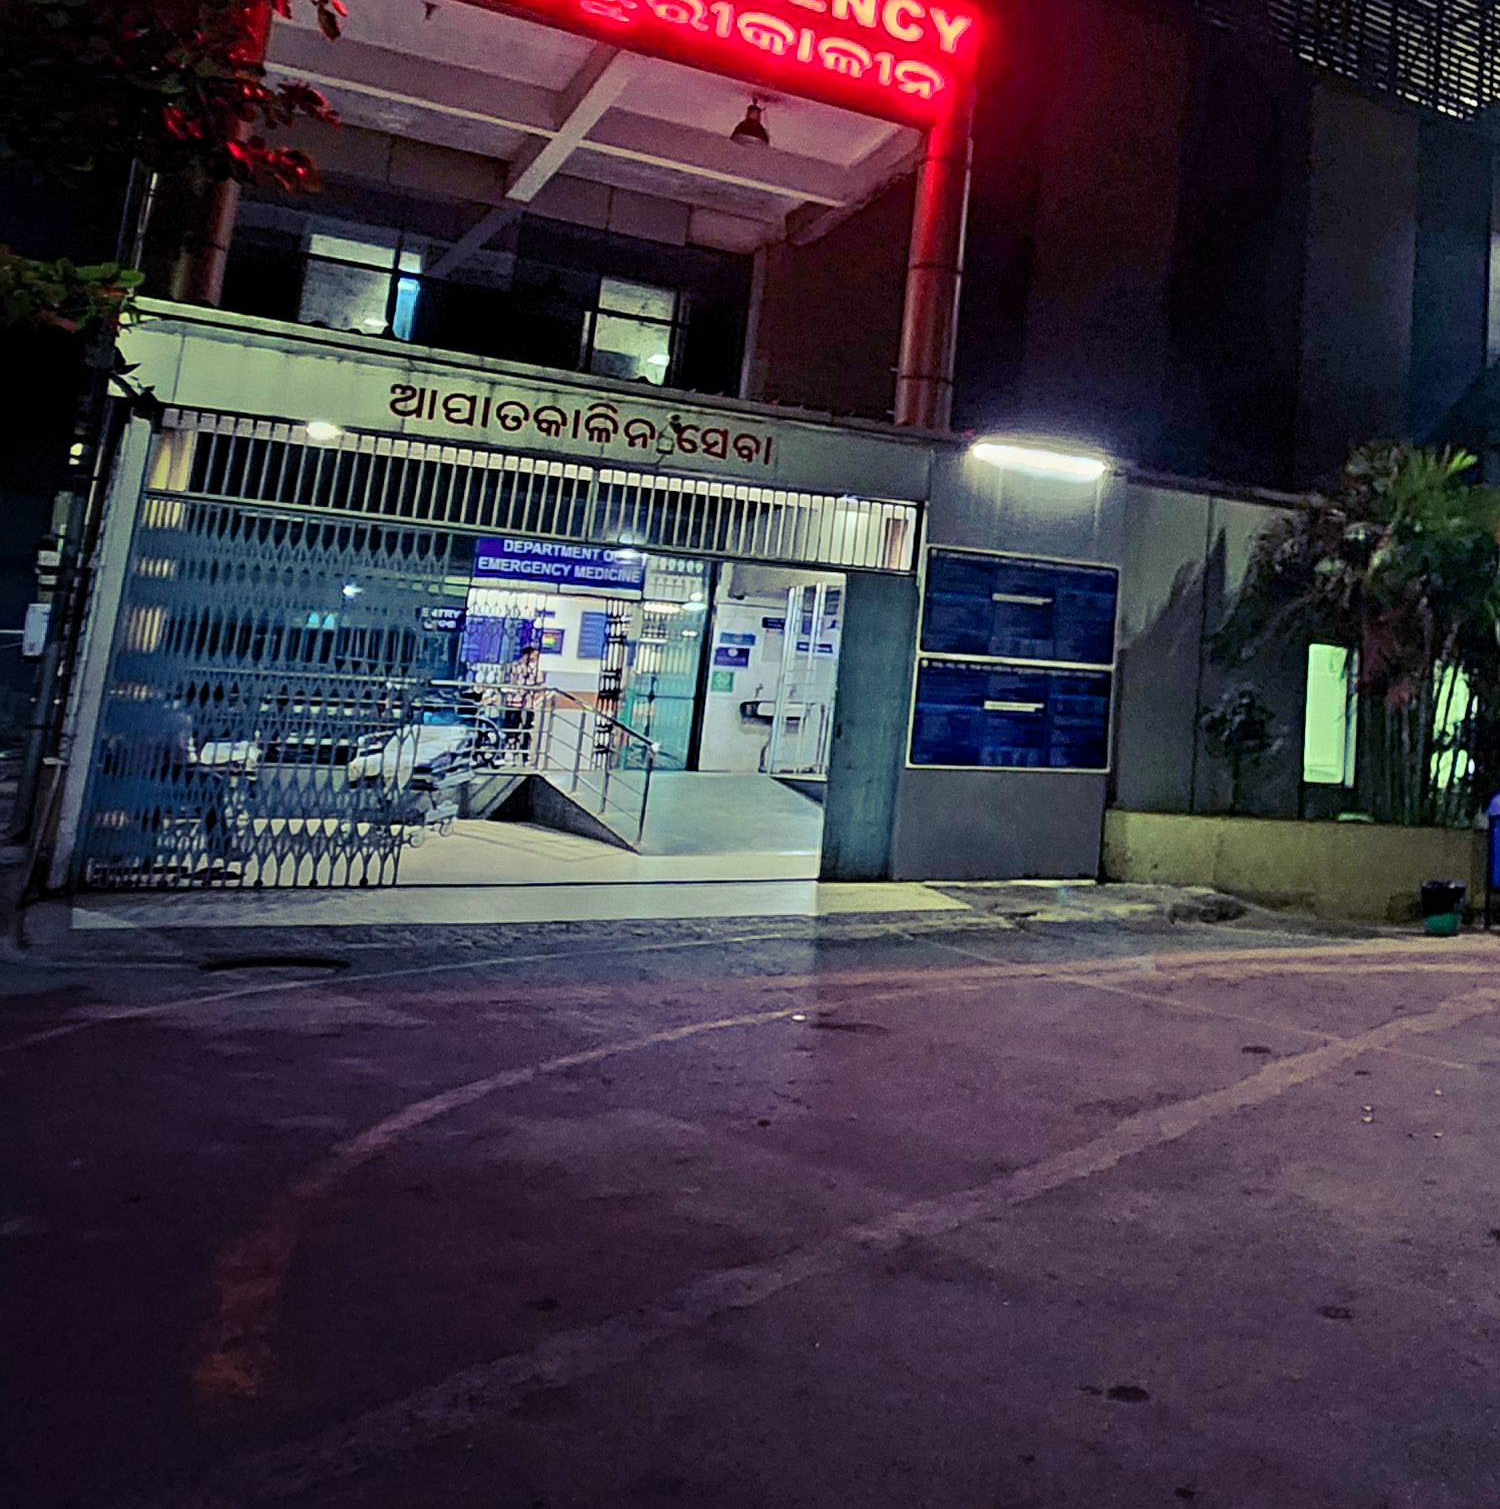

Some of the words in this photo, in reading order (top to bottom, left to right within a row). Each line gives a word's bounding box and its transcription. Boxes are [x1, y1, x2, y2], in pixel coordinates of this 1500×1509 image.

[676, 423, 773, 465] ସେବା
[503, 538, 602, 561] DEPARTMENT
[477, 556, 571, 577] EMERGENCY
[574, 564, 641, 583] MEDICINE
